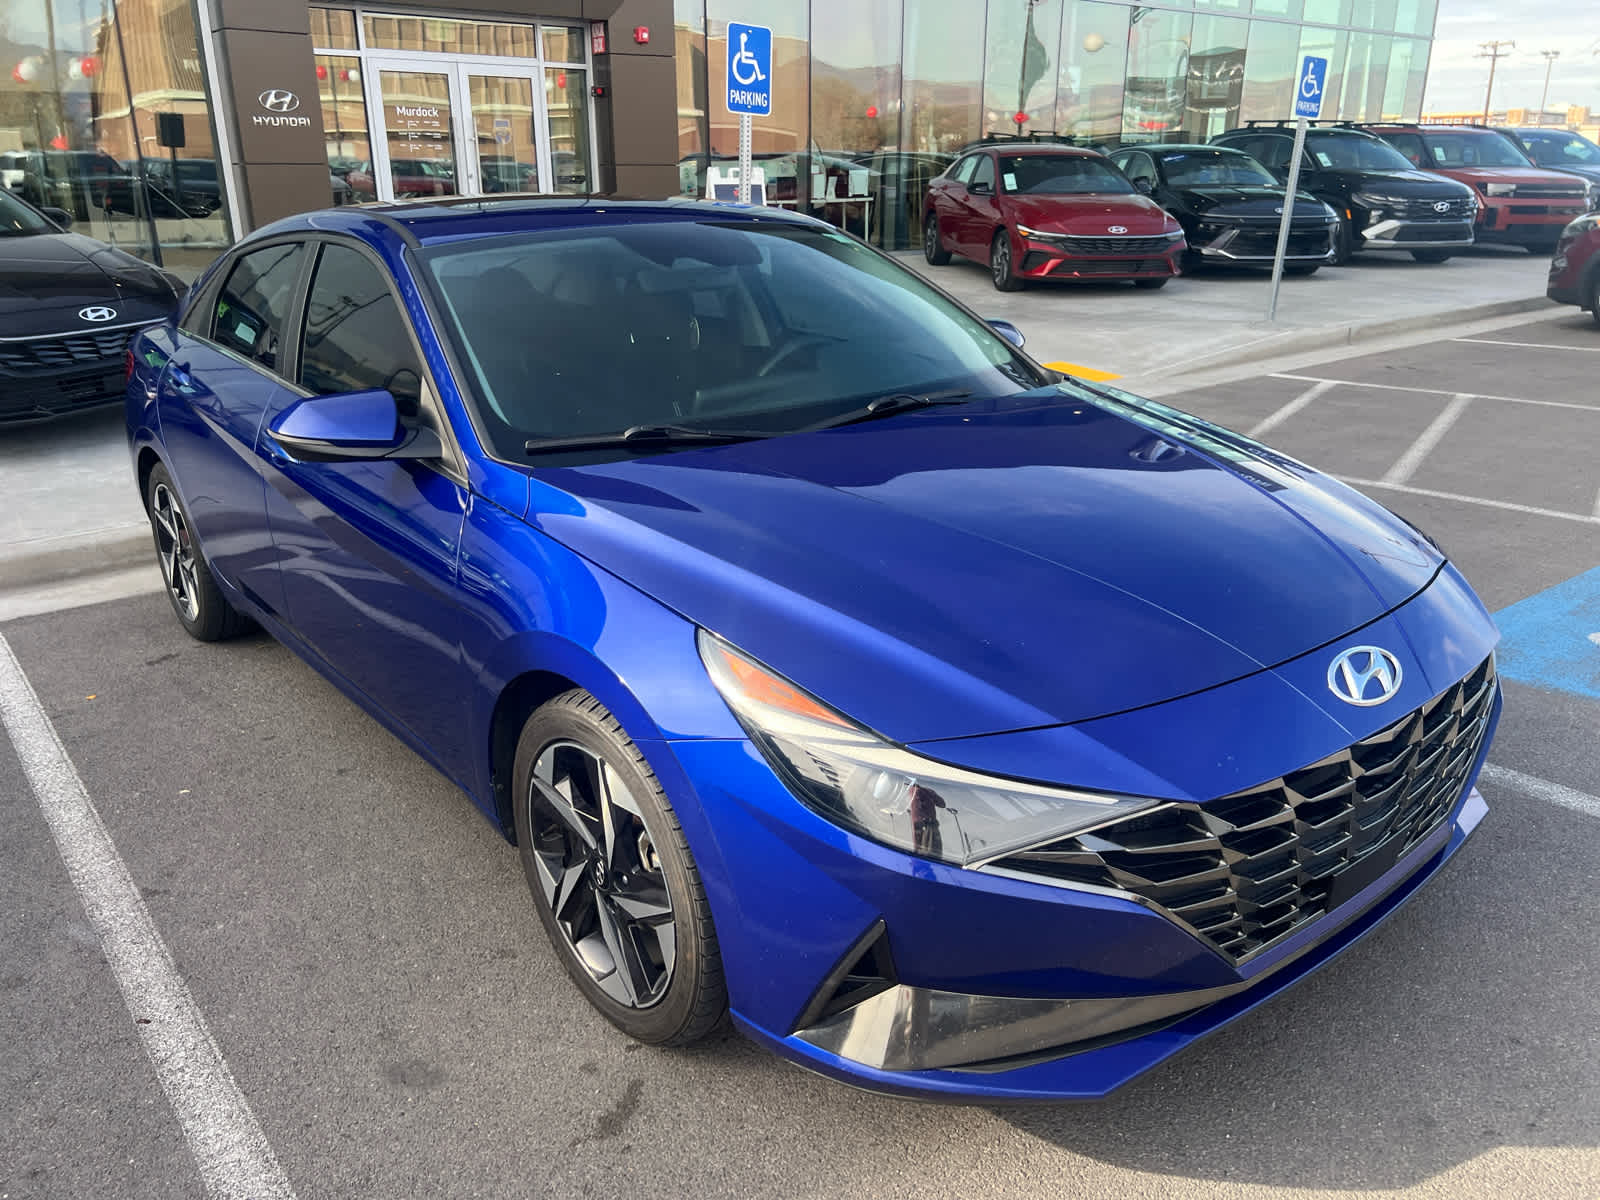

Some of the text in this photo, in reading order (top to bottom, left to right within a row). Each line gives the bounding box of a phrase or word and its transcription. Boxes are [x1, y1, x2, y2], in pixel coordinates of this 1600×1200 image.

[730, 89, 768, 107] PARKING
[396, 106, 439, 117] Murdock
[1297, 100, 1319, 113] PARKING
[252, 115, 311, 127] HYUNDAI
